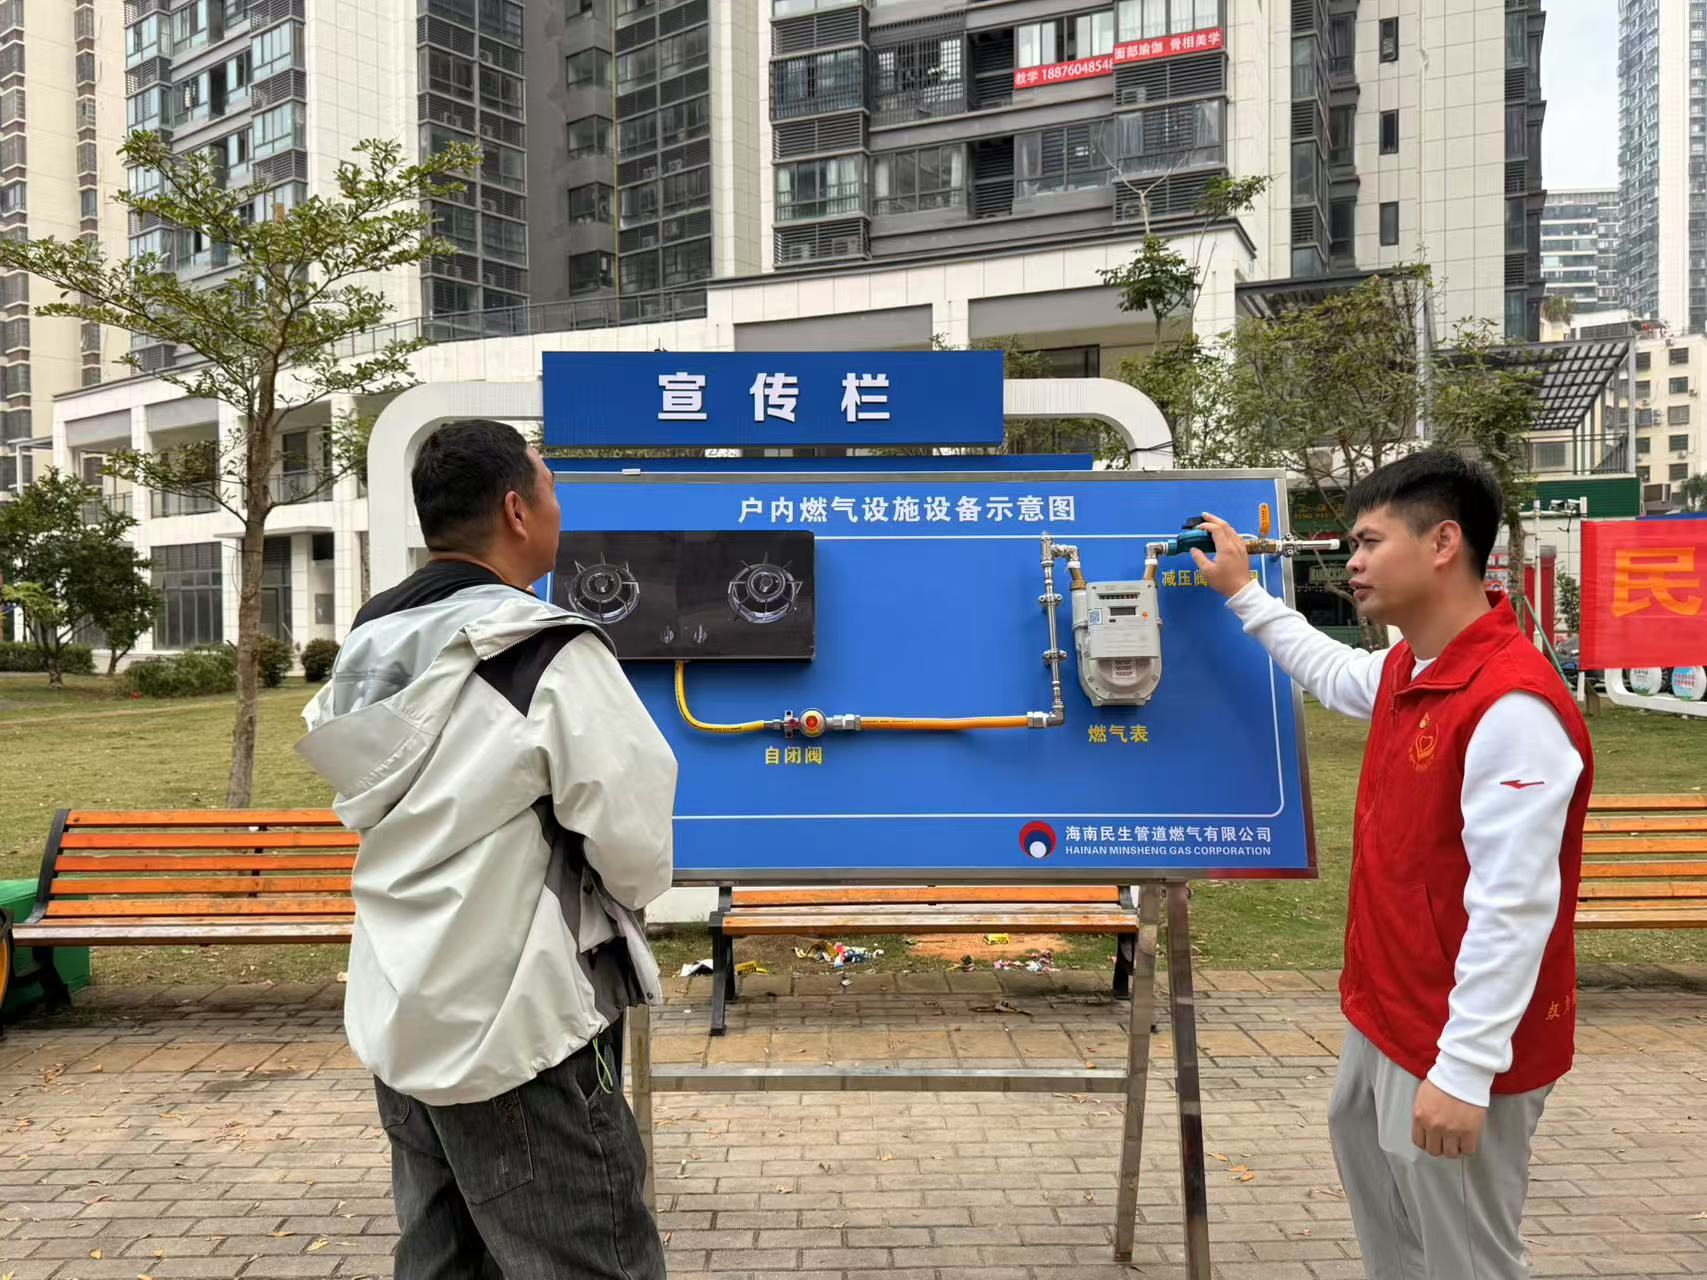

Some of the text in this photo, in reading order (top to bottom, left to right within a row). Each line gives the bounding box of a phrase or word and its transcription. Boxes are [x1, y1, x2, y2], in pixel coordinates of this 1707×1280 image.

[1170, 31, 1221, 51] 骨相美学
[1015, 70, 1039, 85] 教学
[658, 372, 890, 422] 宣传栏
[738, 495, 1076, 523] 户内燃气设施设备示意图
[1612, 547, 1703, 617] 民
[1088, 725, 1149, 743] 燃气表
[764, 746, 824, 765] 自闭阀
[1065, 825, 1273, 842] 海南民生管道燃气有限公司
[1065, 845, 1272, 856] HAINAN MINSHENG GAS CORPORATION
